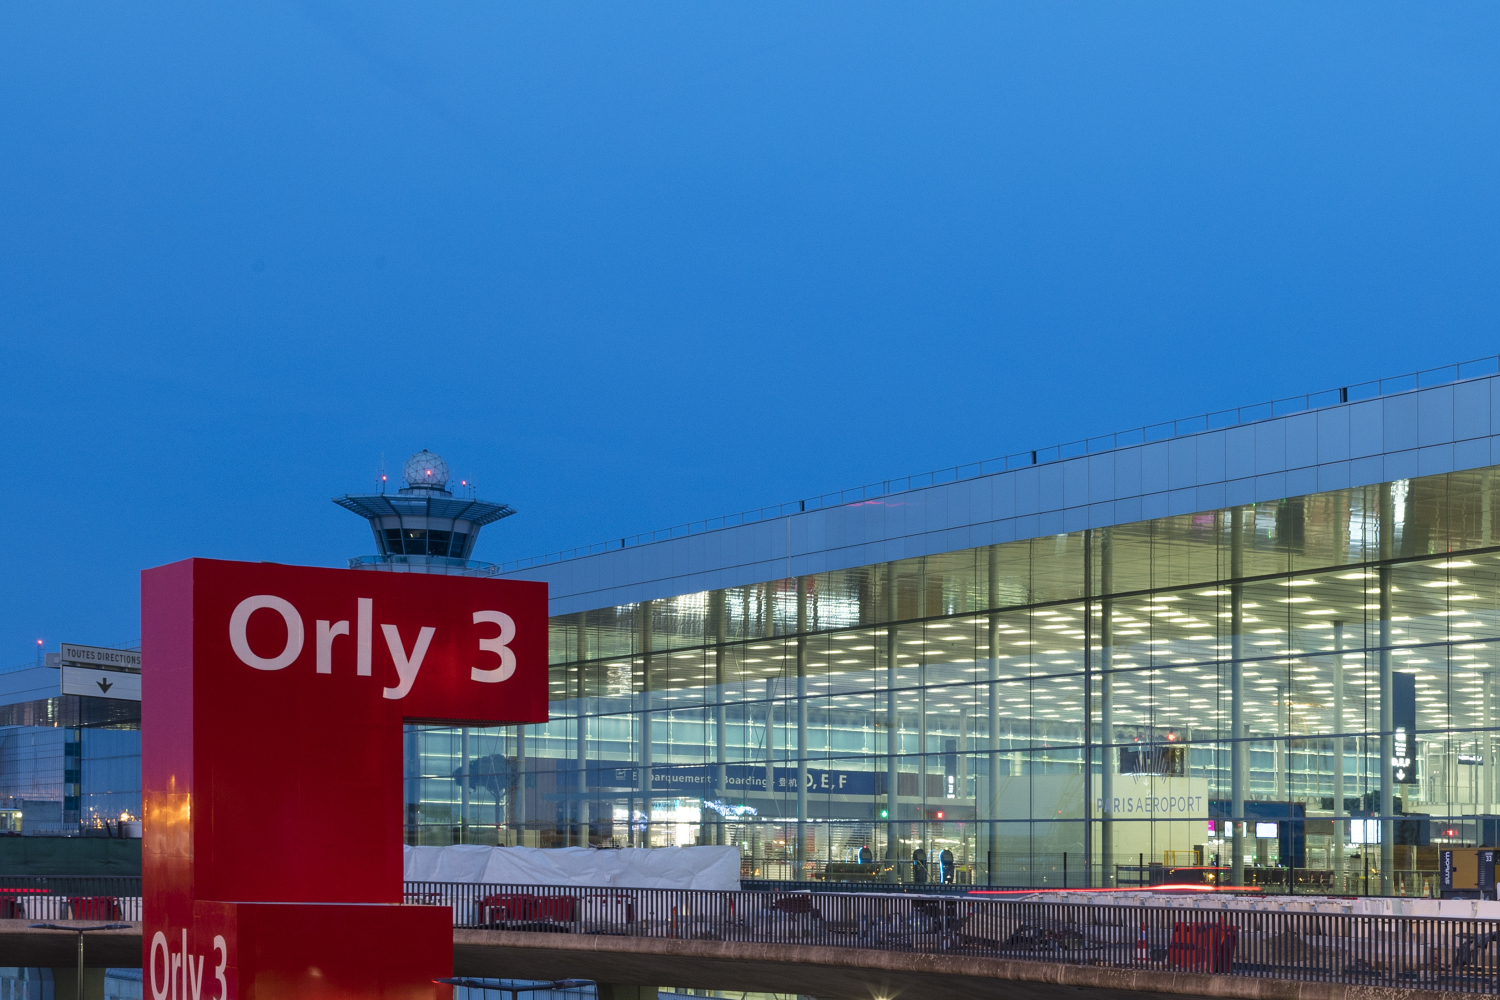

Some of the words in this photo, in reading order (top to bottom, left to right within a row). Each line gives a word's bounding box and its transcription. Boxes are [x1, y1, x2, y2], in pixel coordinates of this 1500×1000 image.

[67, 648, 95, 660] TOUTES
[97, 652, 141, 665] DIRECTIONS
[229, 594, 436, 699] Orly
[470, 610, 516, 683] 3
